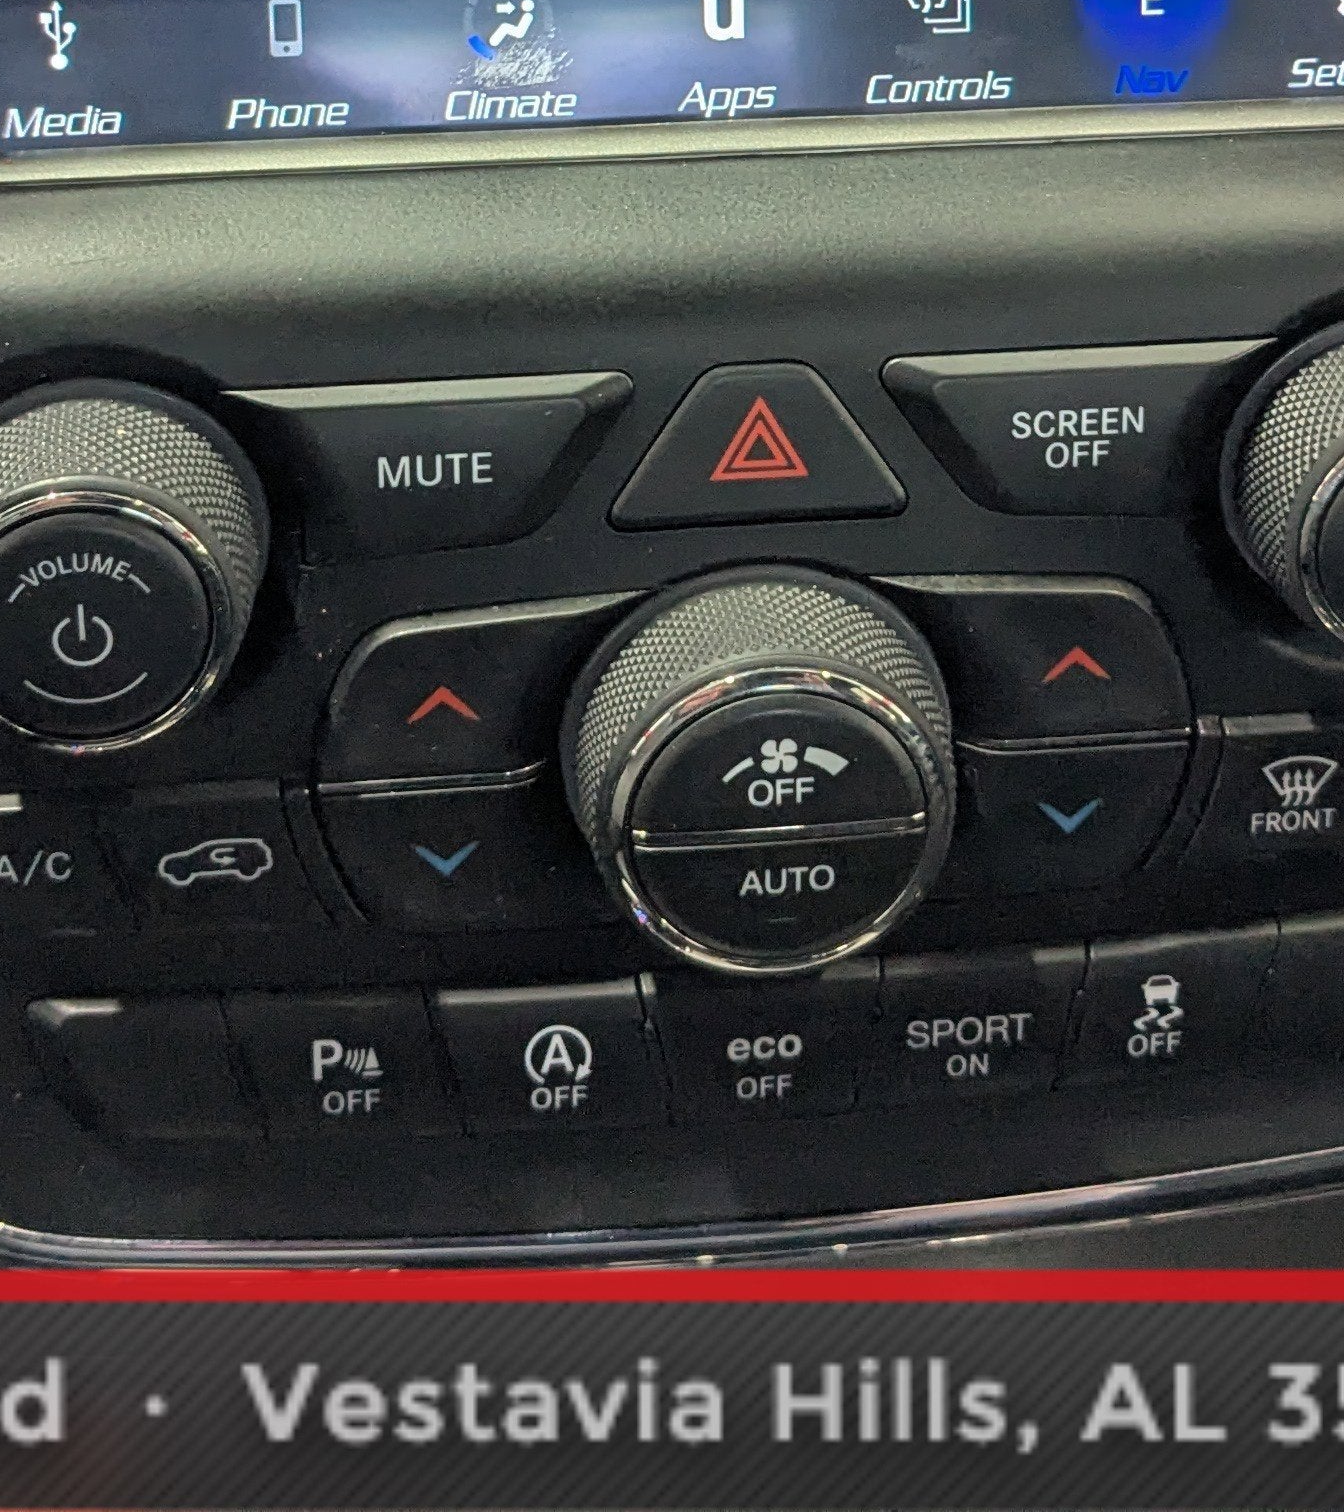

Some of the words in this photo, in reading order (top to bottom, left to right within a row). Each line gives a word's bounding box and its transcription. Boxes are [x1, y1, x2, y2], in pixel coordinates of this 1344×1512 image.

[865, 69, 1013, 106] Controls
[1116, 64, 1189, 96] Nav
[445, 88, 578, 123] Climate
[678, 80, 777, 115] Apps
[1, 105, 124, 139] Media
[226, 97, 350, 132] Phone
[1011, 406, 1146, 440] SCREEN
[1045, 439, 1111, 470] OFF
[377, 453, 493, 489] MUTE
[20, 553, 132, 587] VOLUME
[747, 777, 815, 808] OFF
[1251, 806, 1337, 836] FRONT
[739, 864, 836, 897] AUTO
[906, 1012, 1032, 1050] SPORT
[1127, 1029, 1183, 1059] OFF
[726, 1032, 803, 1063] eco
[947, 1051, 990, 1078] ON
[323, 1088, 380, 1114] OFF
[531, 1085, 588, 1111] OFF
[736, 1070, 793, 1100] OFF
